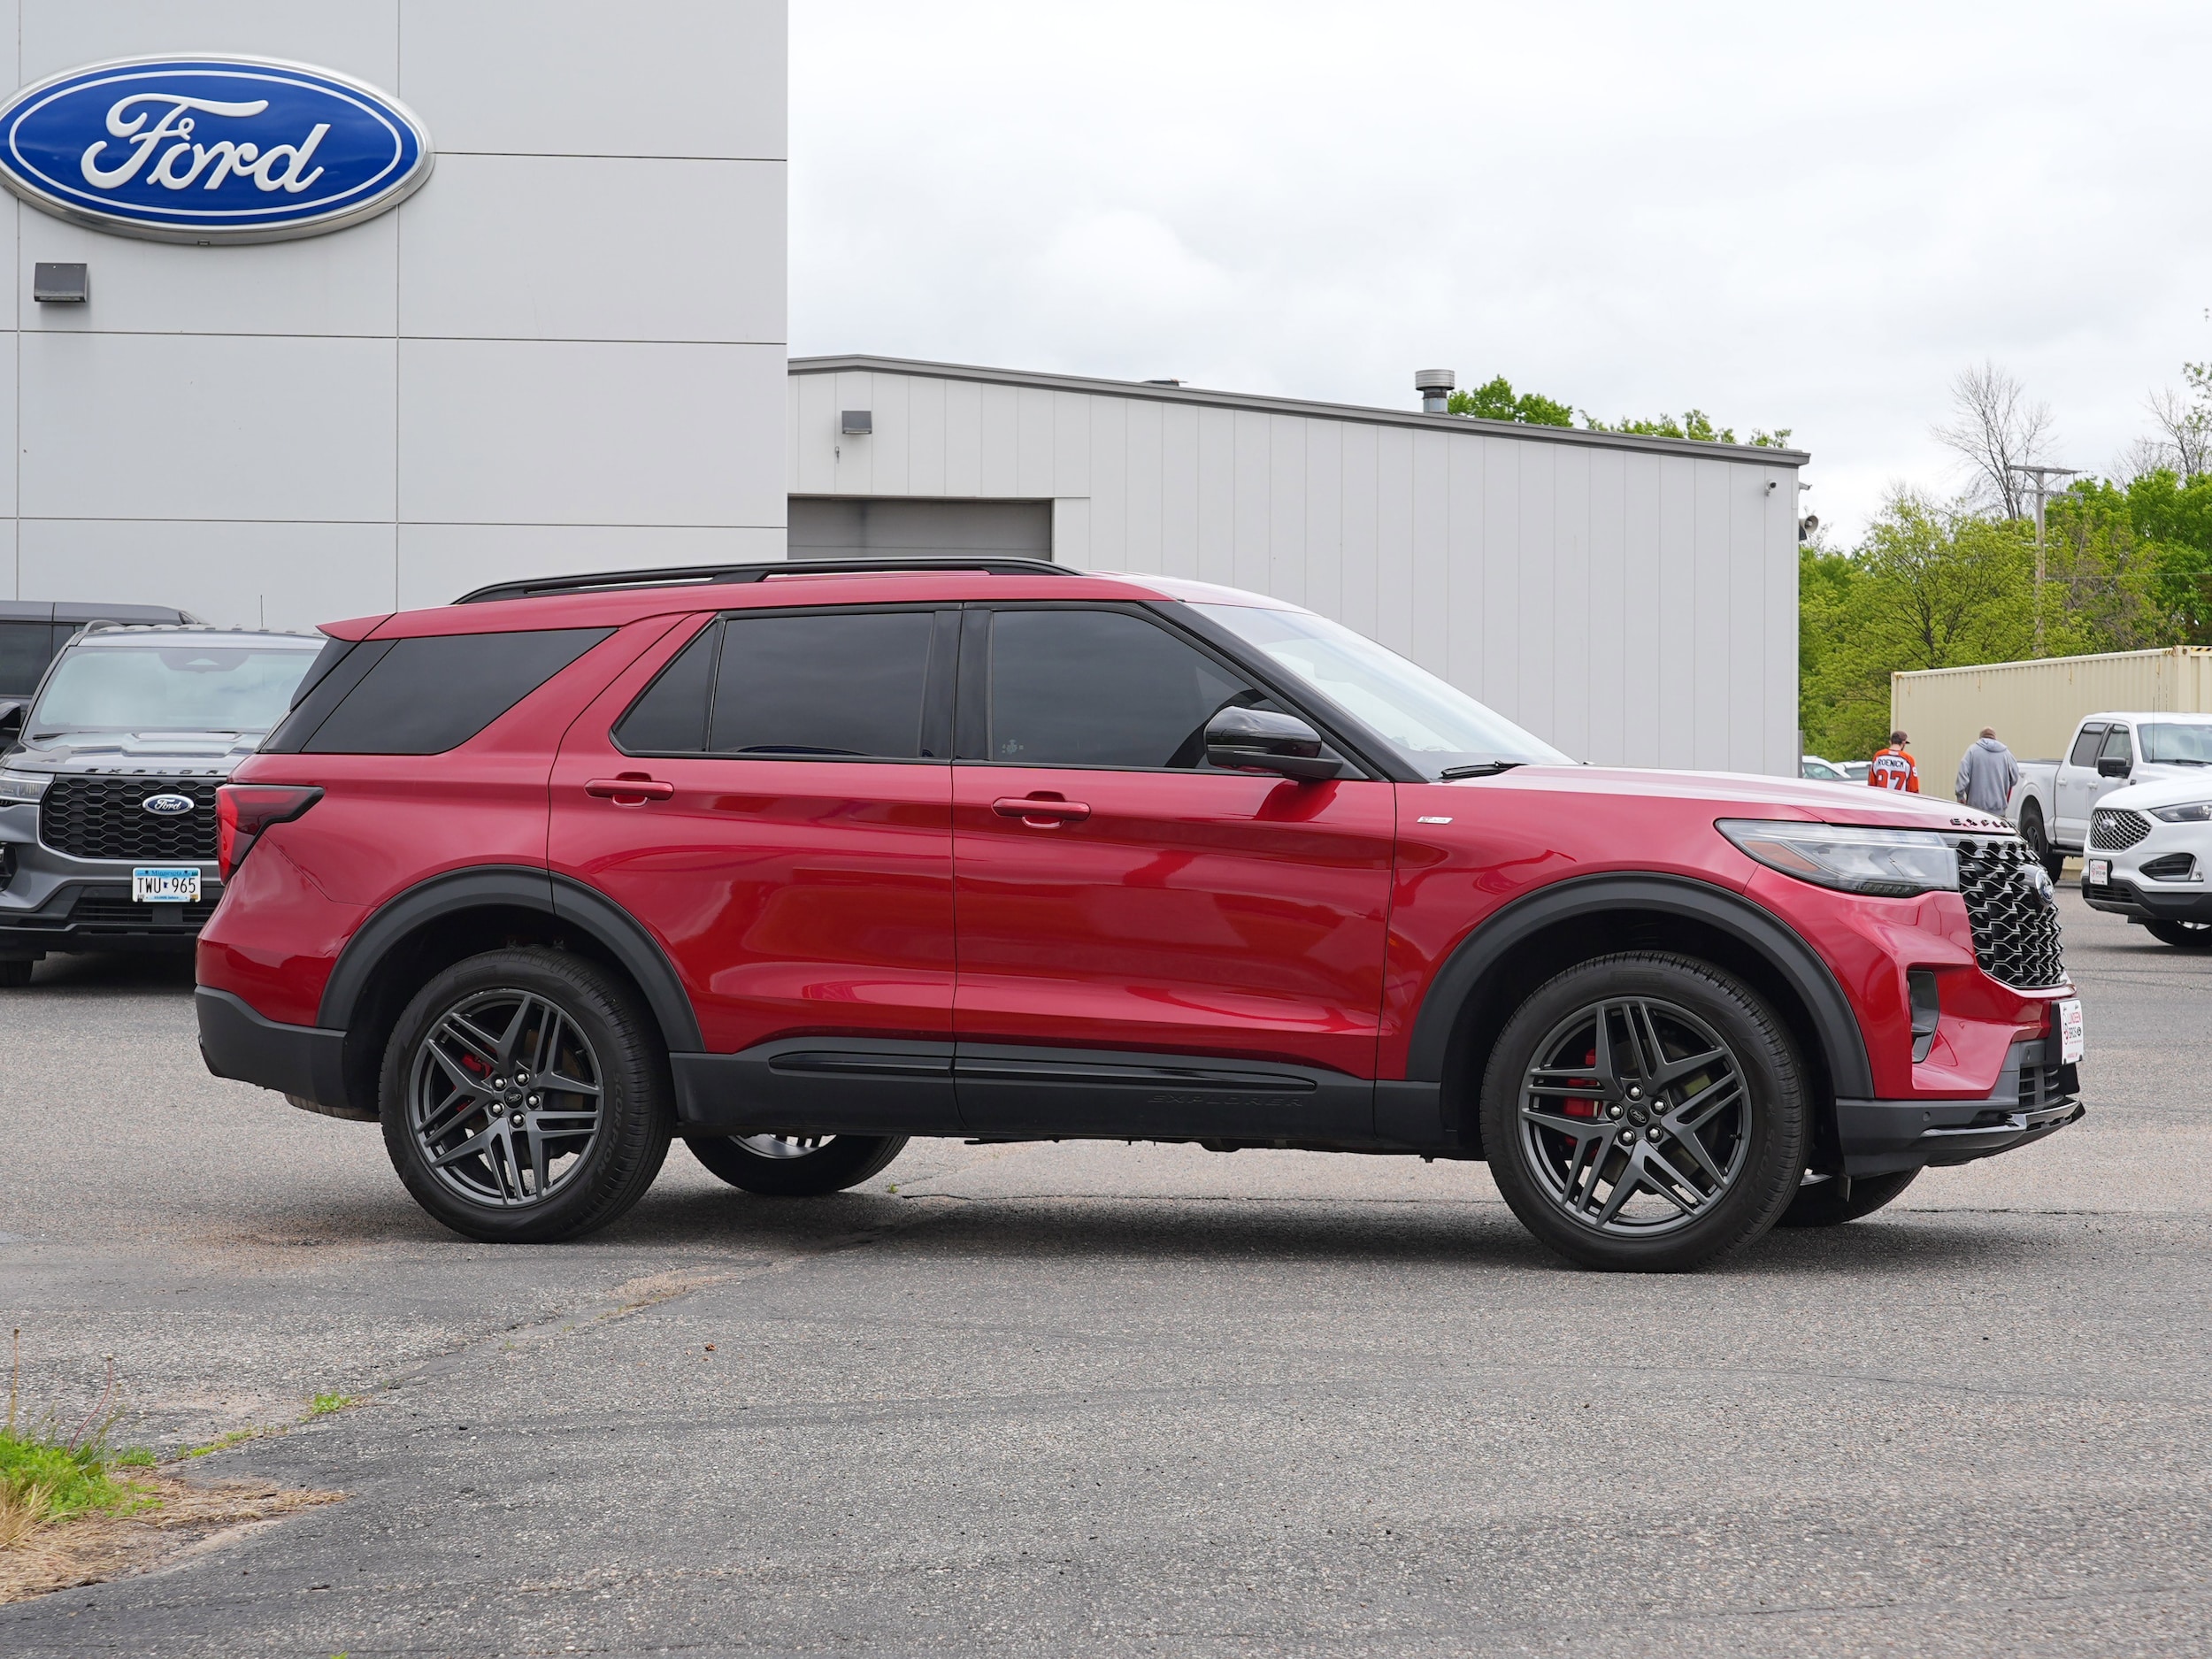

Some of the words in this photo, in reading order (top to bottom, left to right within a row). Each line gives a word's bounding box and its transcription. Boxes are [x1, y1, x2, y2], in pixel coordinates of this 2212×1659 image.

[81, 92, 331, 194] Ford
[1876, 769, 1907, 790] 97
[154, 798, 182, 810] Ford
[137, 877, 161, 894] TWU
[172, 877, 196, 894] 965
[1147, 1094, 1303, 1107] EXPLORER
[596, 1071, 623, 1177] SCORPION
